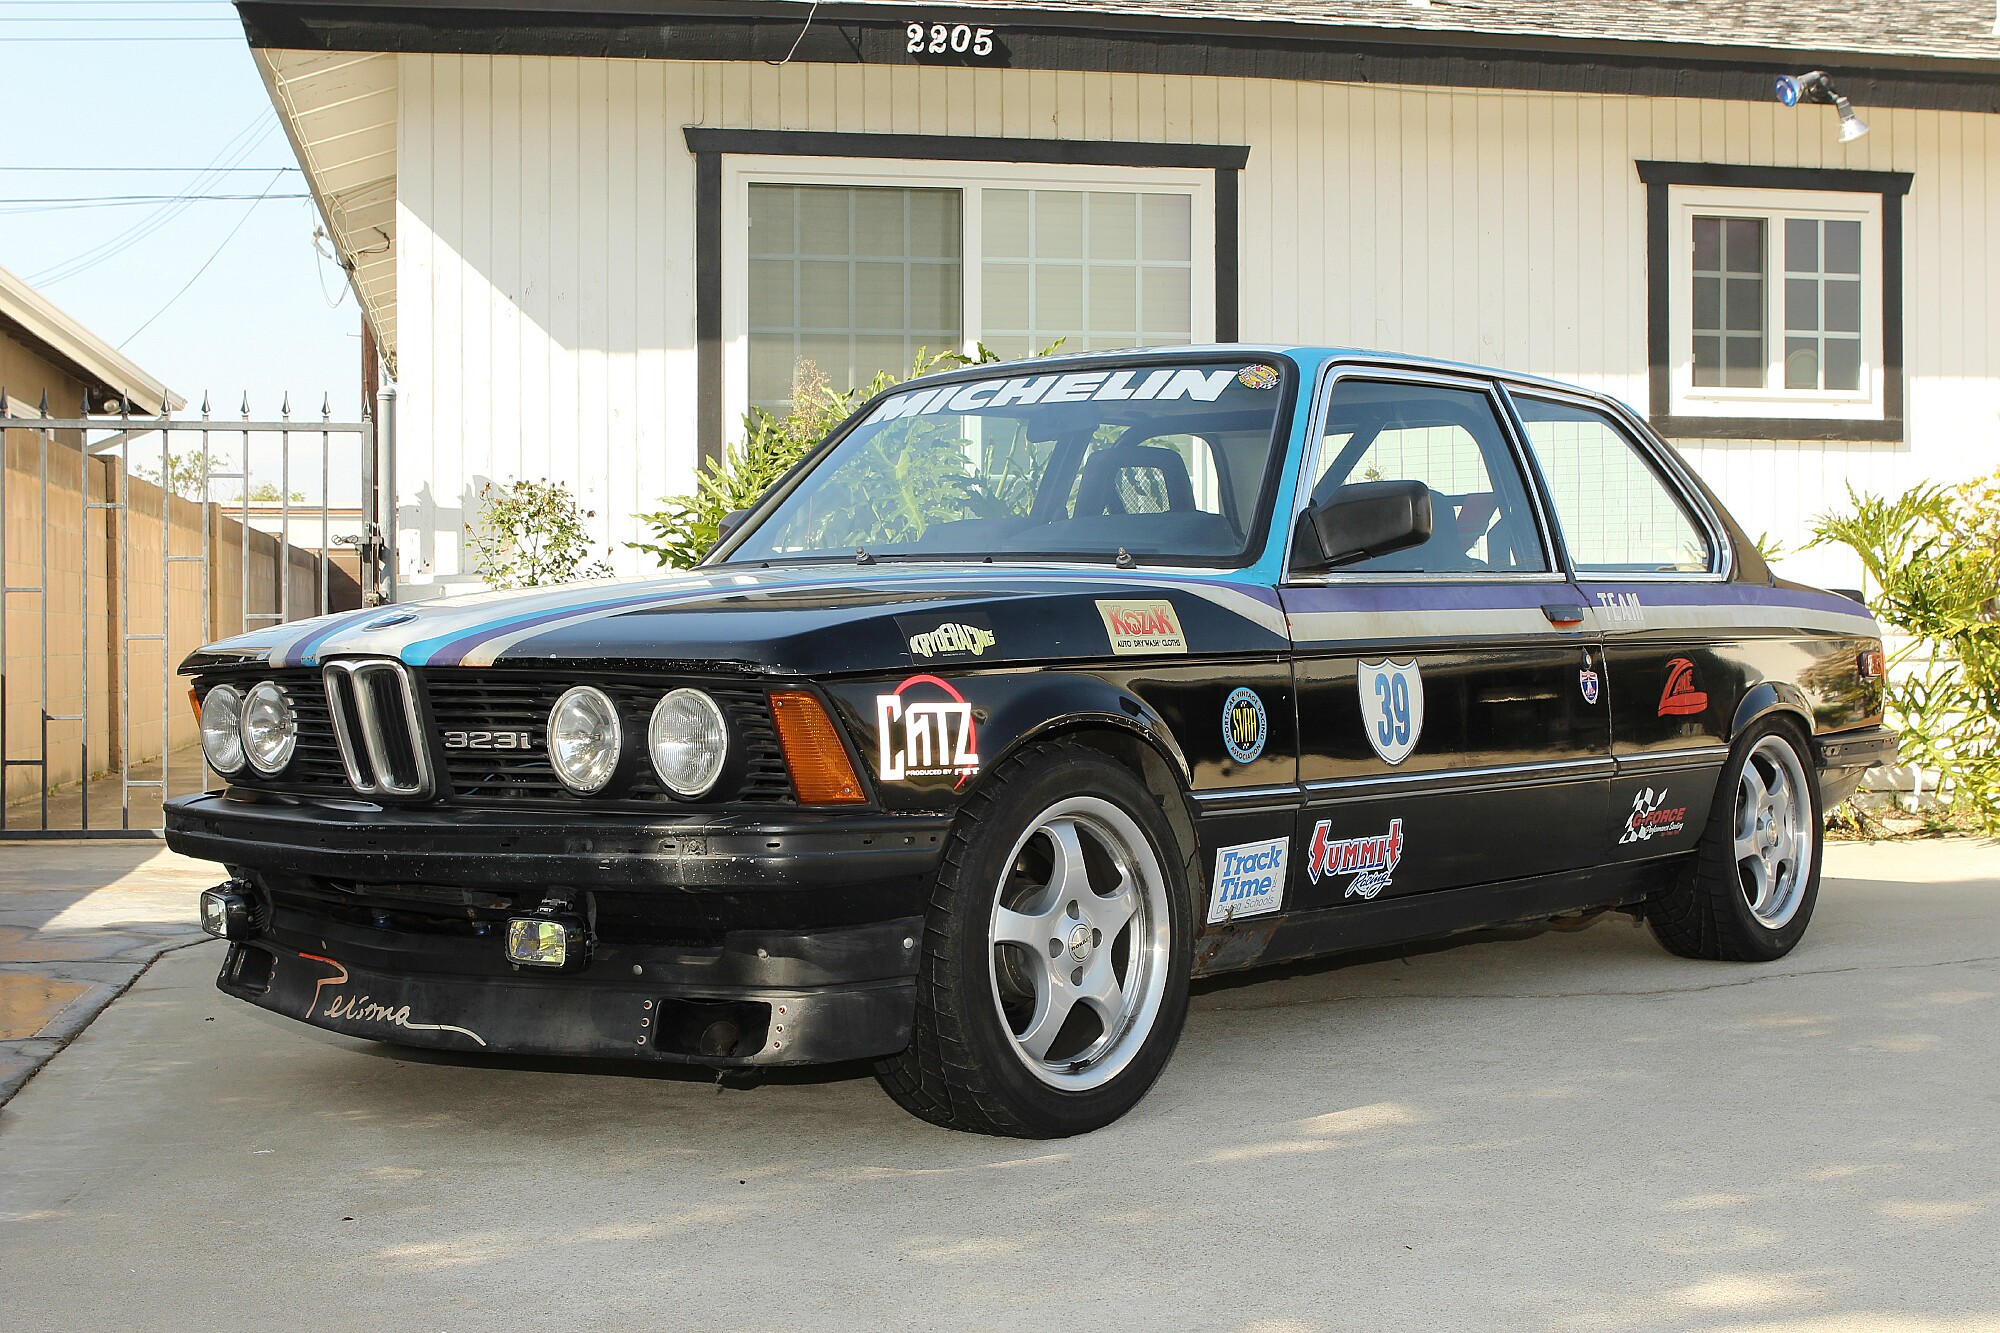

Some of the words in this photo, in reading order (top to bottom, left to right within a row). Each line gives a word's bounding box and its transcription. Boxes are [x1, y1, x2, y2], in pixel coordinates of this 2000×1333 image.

[906, 23, 994, 56] 2205
[863, 369, 1238, 427] MICHELIN
[1103, 605, 1177, 636] KOZAK
[1596, 592, 1644, 621] TEAM
[1117, 639, 1132, 648] AUTO
[1162, 639, 1181, 647] CLOTHS
[1236, 690, 1258, 704] VINTAGE
[1258, 706, 1266, 741] RACING
[1375, 672, 1411, 747] 39
[876, 694, 980, 781] CATZ
[1232, 707, 1257, 743] SVRA
[445, 731, 532, 749] 323i
[1231, 743, 1262, 761] ASSOCIATION
[905, 769, 942, 777] PRODUCED
[942, 768, 953, 776] BY
[1632, 807, 1687, 828] G-FORCE
[1223, 845, 1283, 877] Track
[1219, 876, 1272, 903] Time
[1345, 870, 1393, 899] Racing
[1244, 895, 1275, 909] Schools
